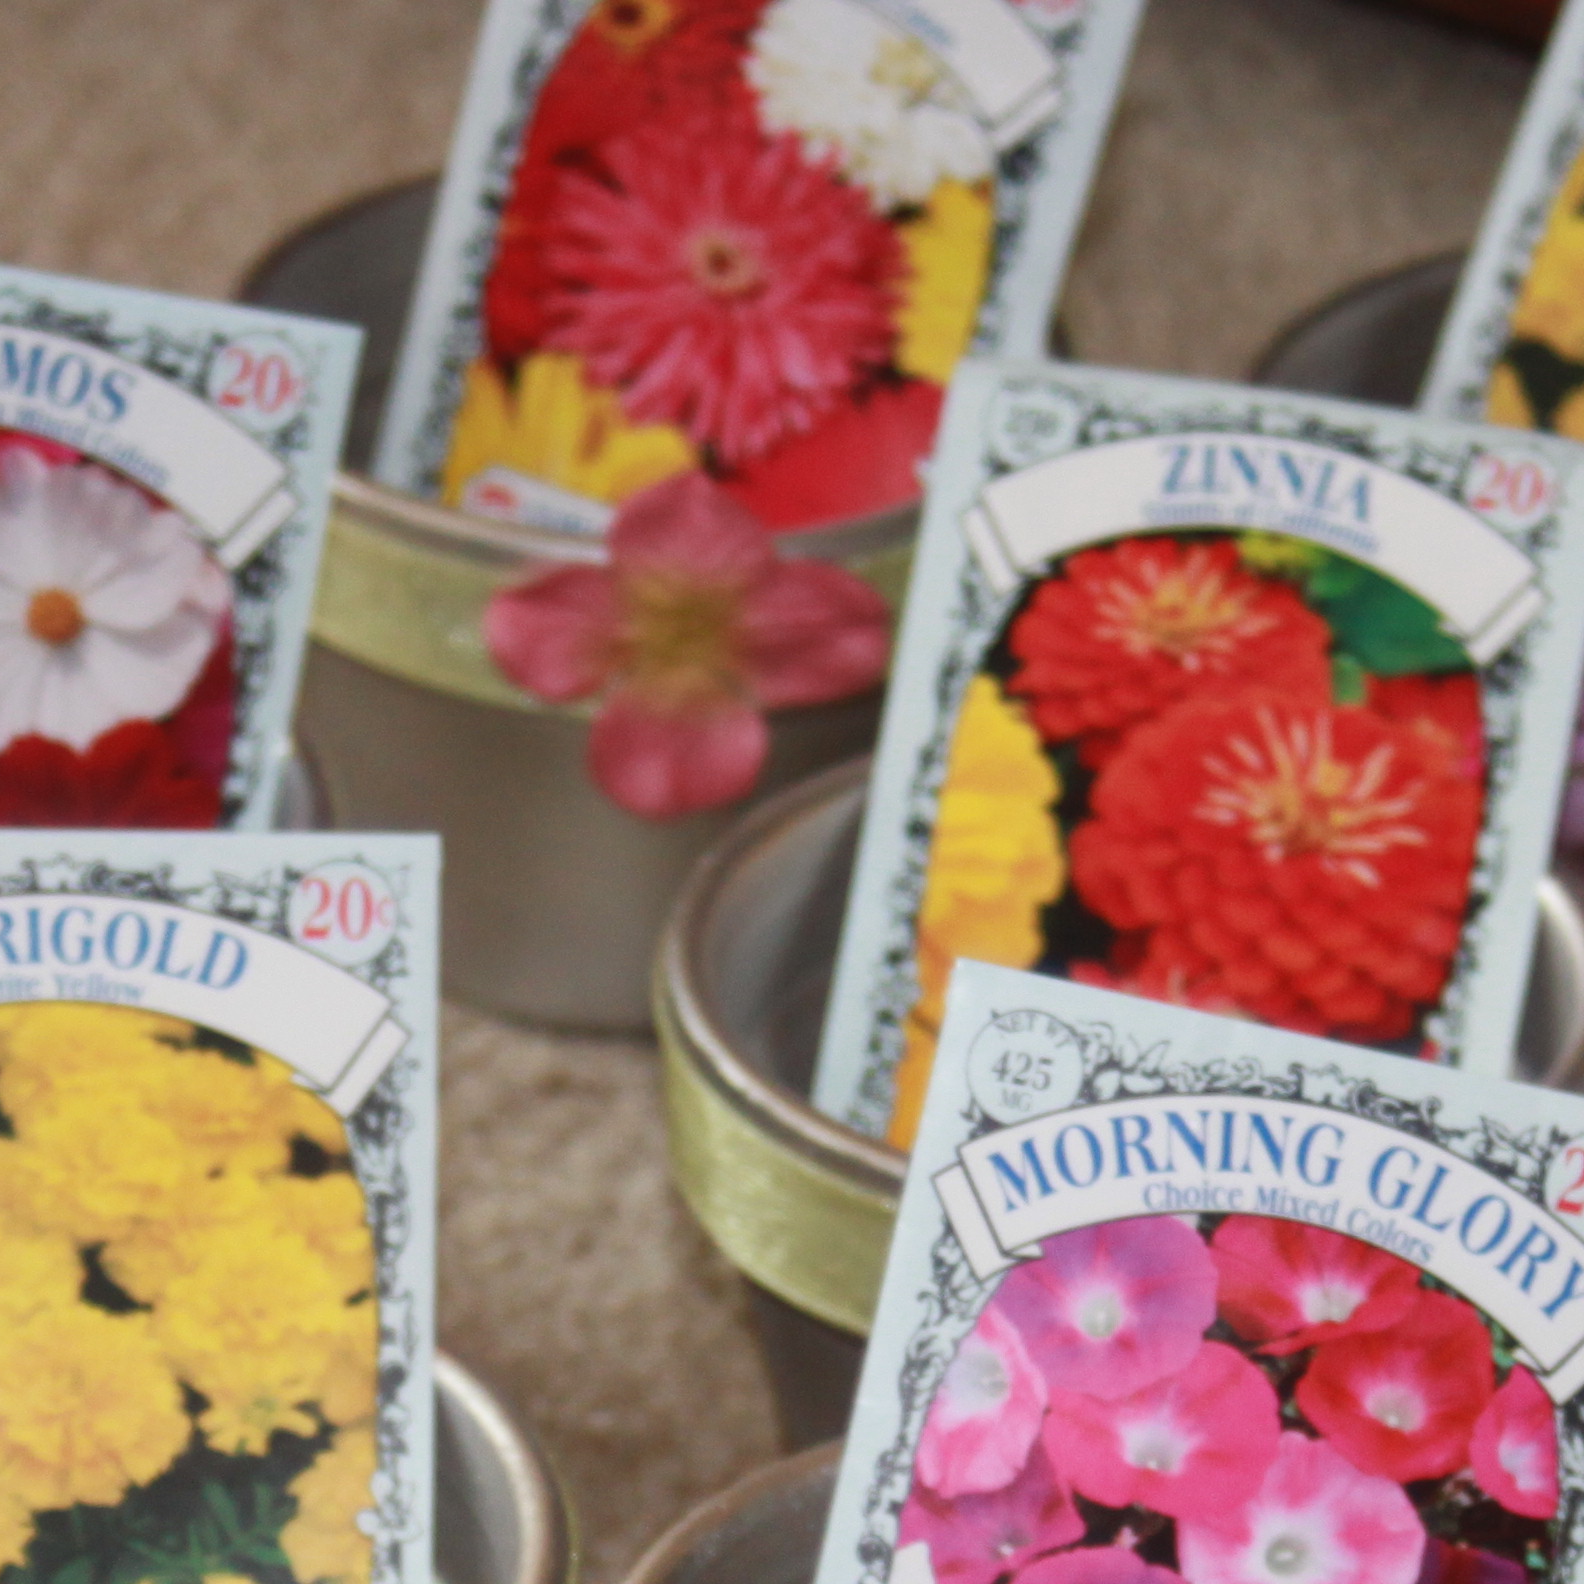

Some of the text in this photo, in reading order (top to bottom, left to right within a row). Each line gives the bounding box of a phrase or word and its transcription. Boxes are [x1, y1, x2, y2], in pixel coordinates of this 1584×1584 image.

[1158, 442, 1370, 524] ZINNIA
[991, 1050, 1053, 1091] 425
[986, 1108, 1347, 1214] MORNING
[1142, 1180, 1435, 1262] Choice Mixed Colors
